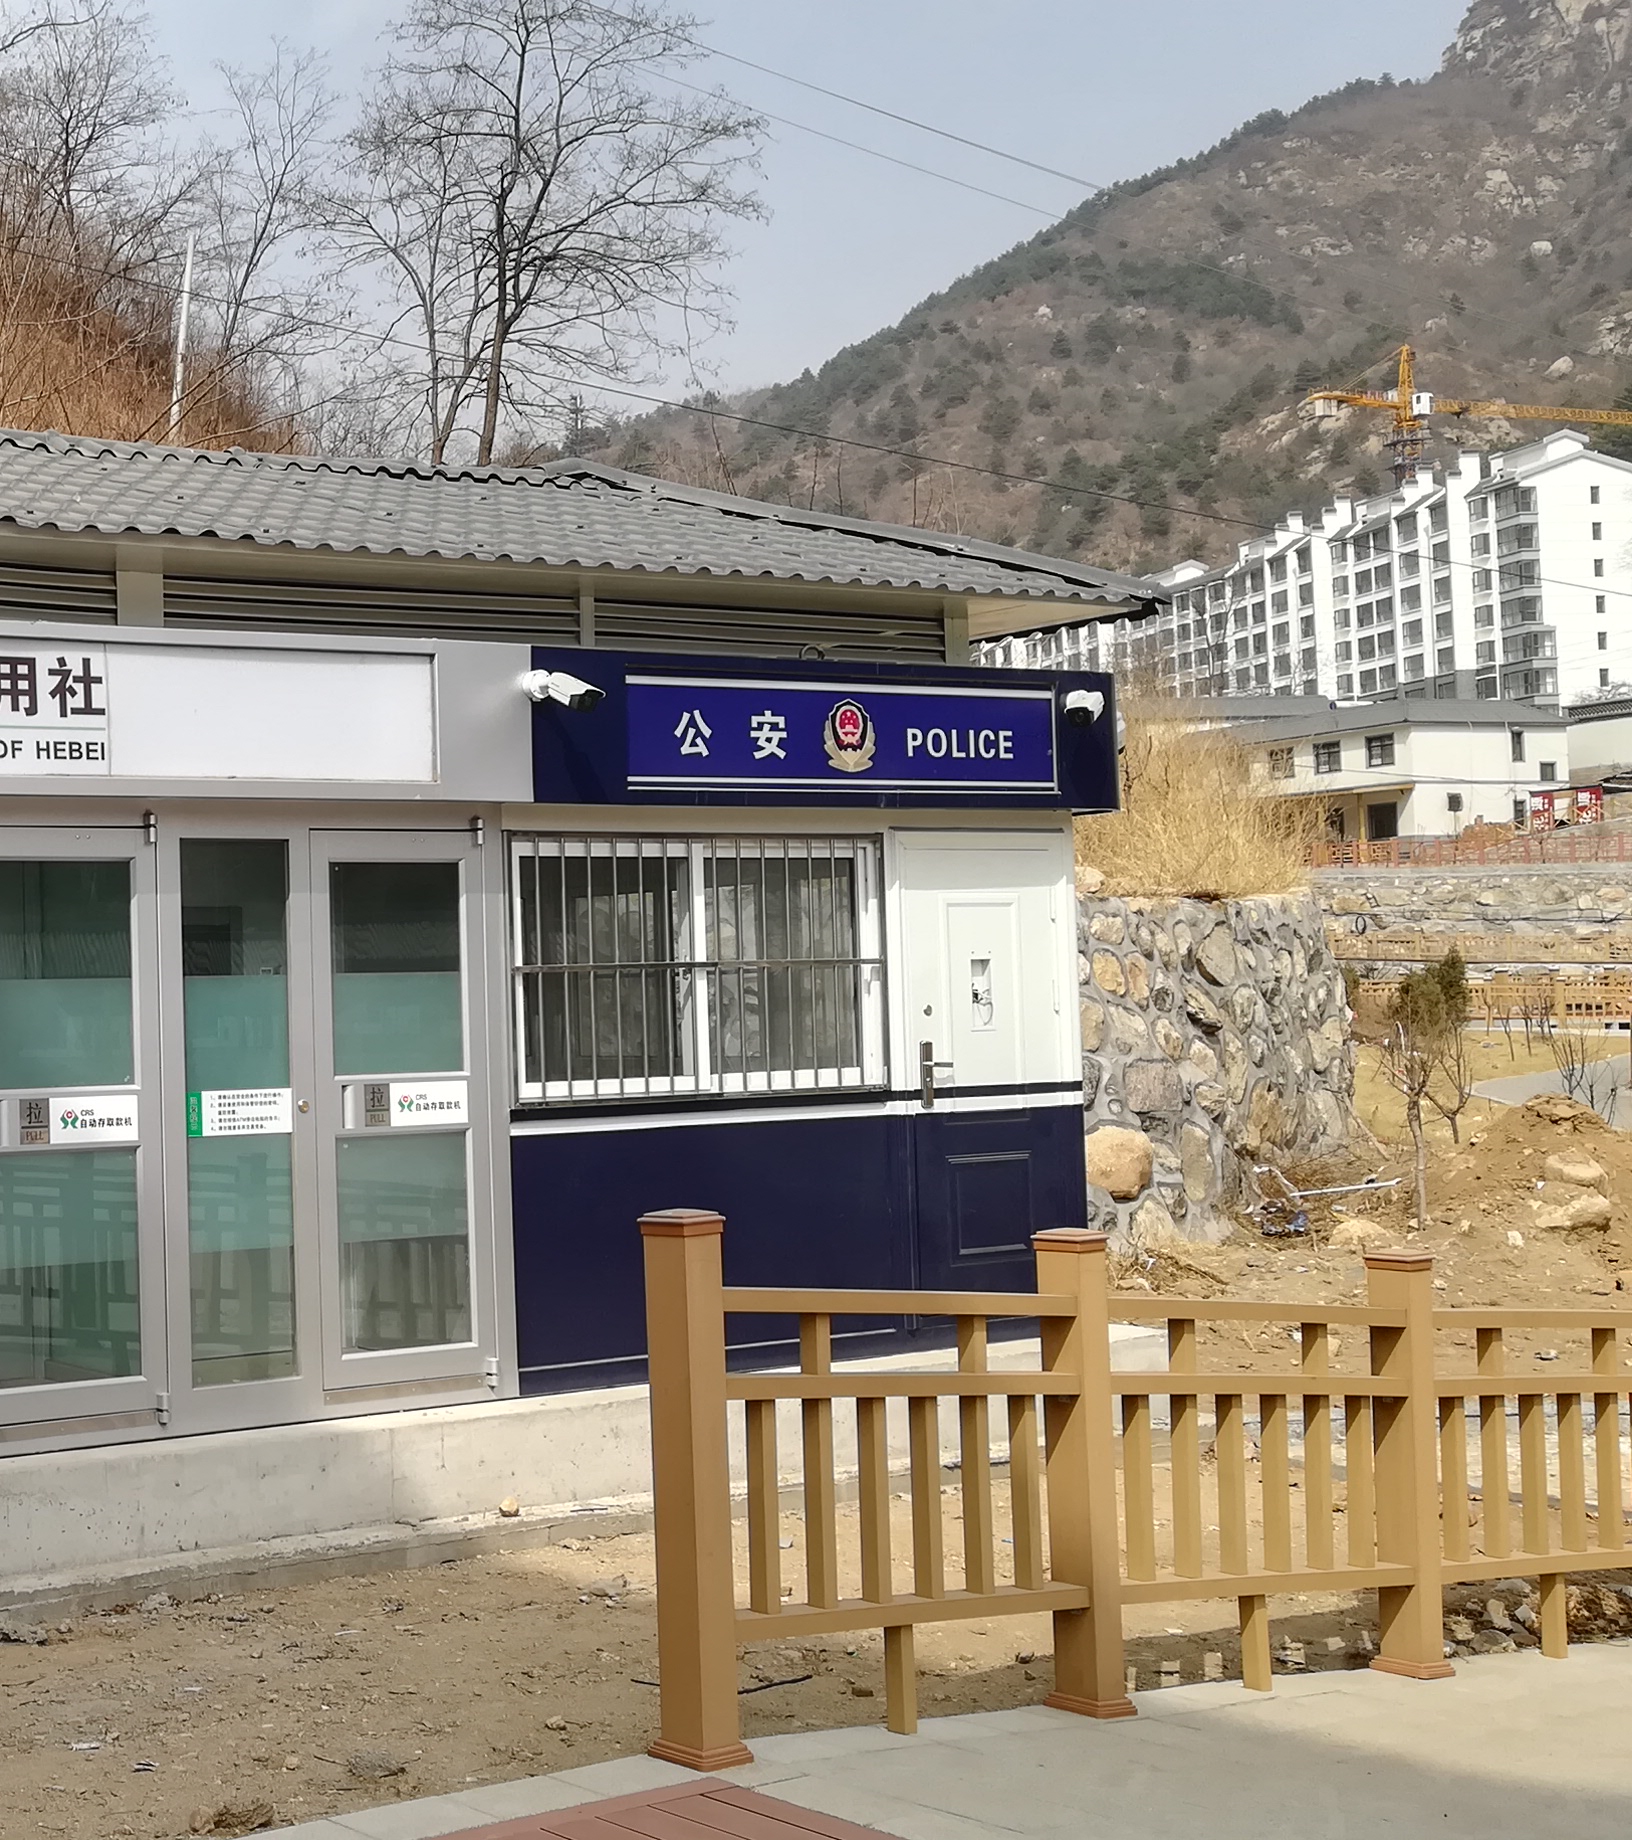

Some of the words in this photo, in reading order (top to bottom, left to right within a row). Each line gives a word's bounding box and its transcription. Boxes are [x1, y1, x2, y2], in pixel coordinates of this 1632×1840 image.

[673, 709, 789, 760] 公安
[905, 727, 1015, 760] POLICE
[36, 740, 106, 761] HEBEI
[370, 1087, 385, 1108] 拉
[26, 1102, 44, 1125] 拉
[80, 1109, 95, 1117] CRS
[415, 1101, 461, 1112] 自动存取款机
[80, 1117, 133, 1129] 自动存取款机
[25, 1130, 44, 1141] PULL
